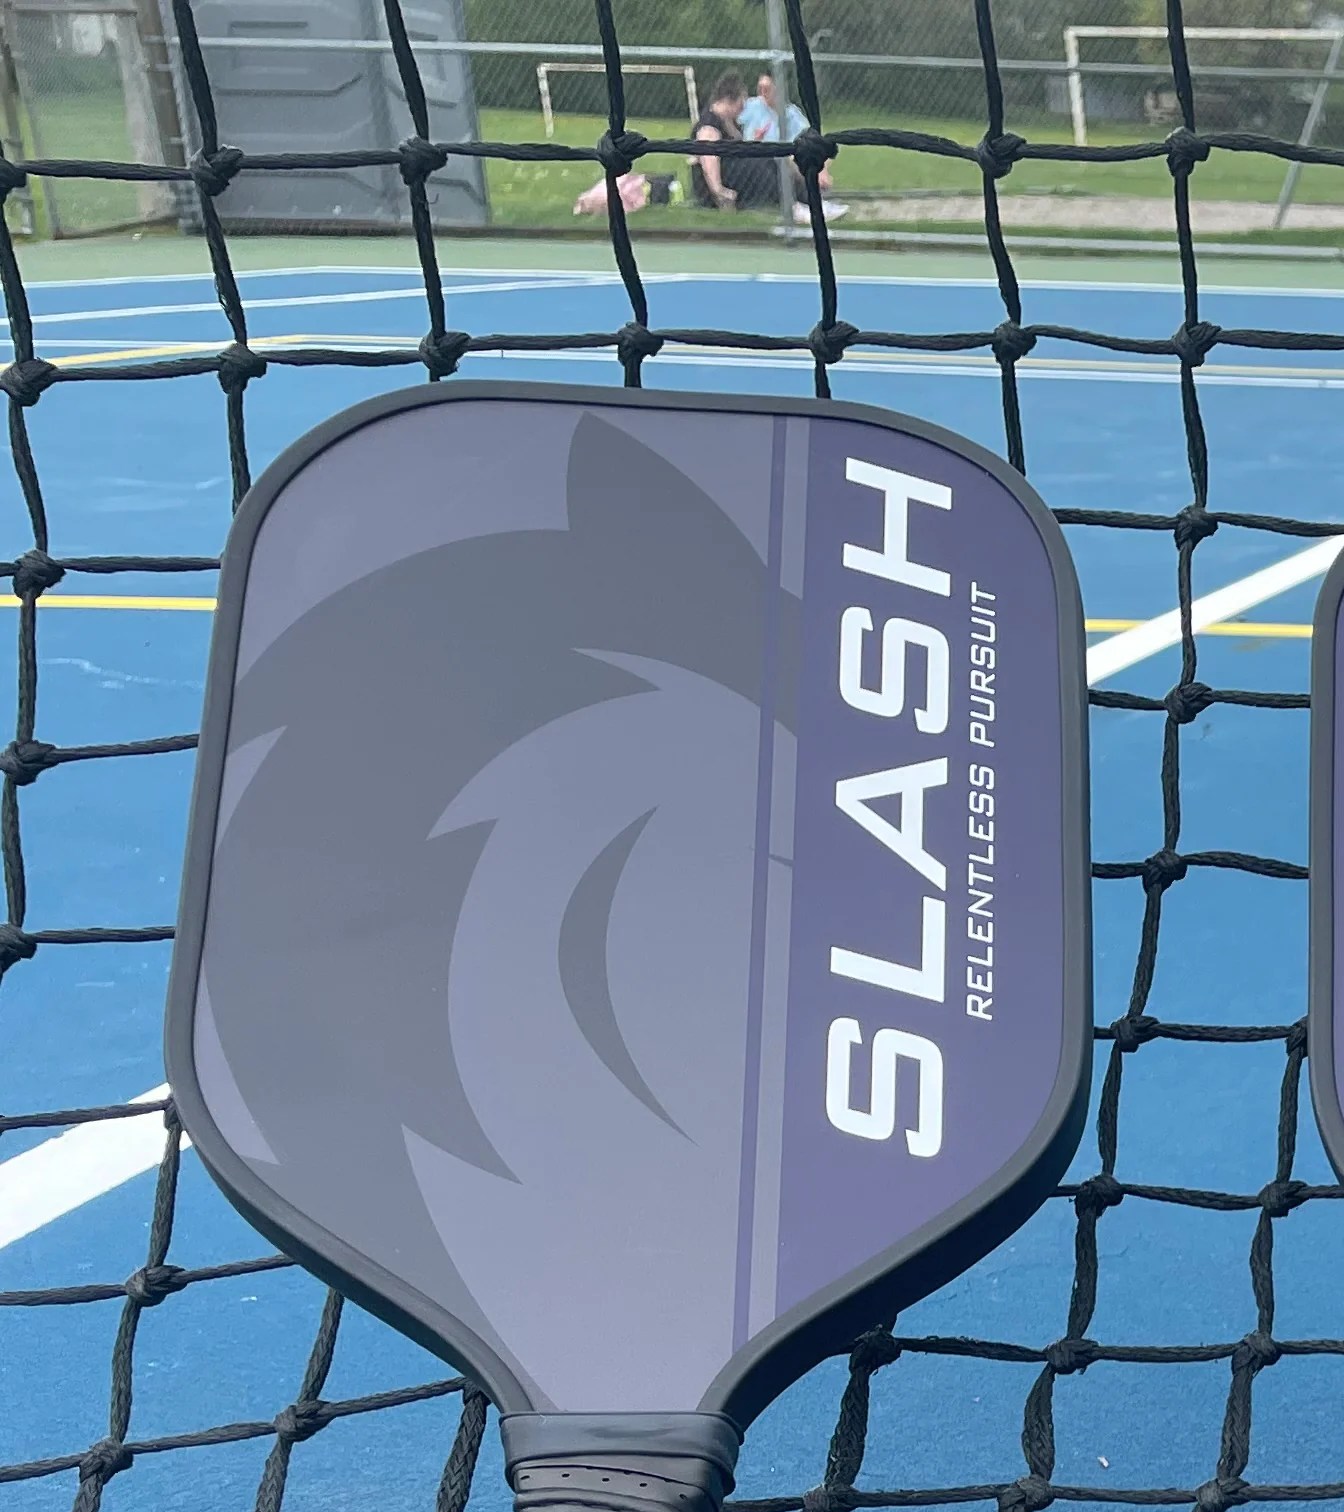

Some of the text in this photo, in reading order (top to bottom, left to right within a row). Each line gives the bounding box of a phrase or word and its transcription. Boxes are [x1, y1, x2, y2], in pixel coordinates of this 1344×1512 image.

[825, 457, 952, 1158] SLASH
[966, 581, 997, 1021] RELENTLESS PURSUIT
